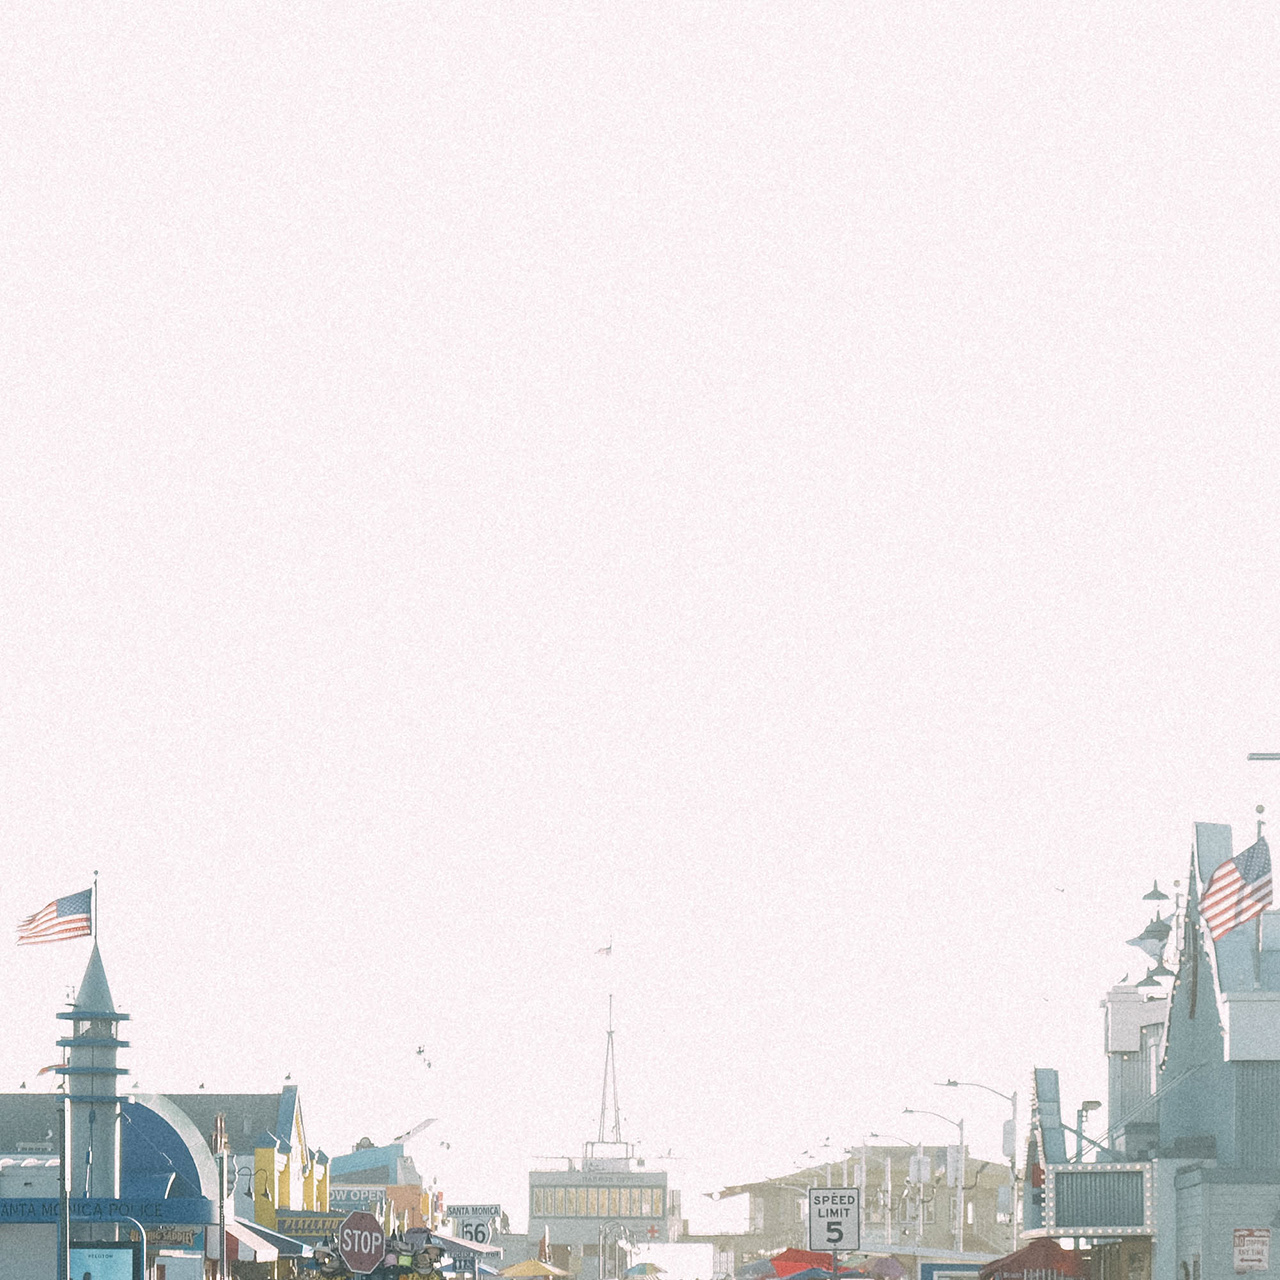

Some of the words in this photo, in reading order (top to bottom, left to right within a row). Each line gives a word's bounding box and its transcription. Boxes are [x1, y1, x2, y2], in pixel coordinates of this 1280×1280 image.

[350, 1190, 385, 1201] OPEN
[813, 1195, 855, 1206] SPEED
[109, 1203, 163, 1218] POLICE
[448, 1206, 470, 1216] SANTA
[471, 1206, 499, 1216] MONICA
[817, 1208, 851, 1218] LIMIT
[284, 1219, 339, 1229] PLAYLAND
[826, 1221, 844, 1244] 5
[342, 1229, 382, 1255] STOP
[1234, 1236, 1245, 1247] NO
